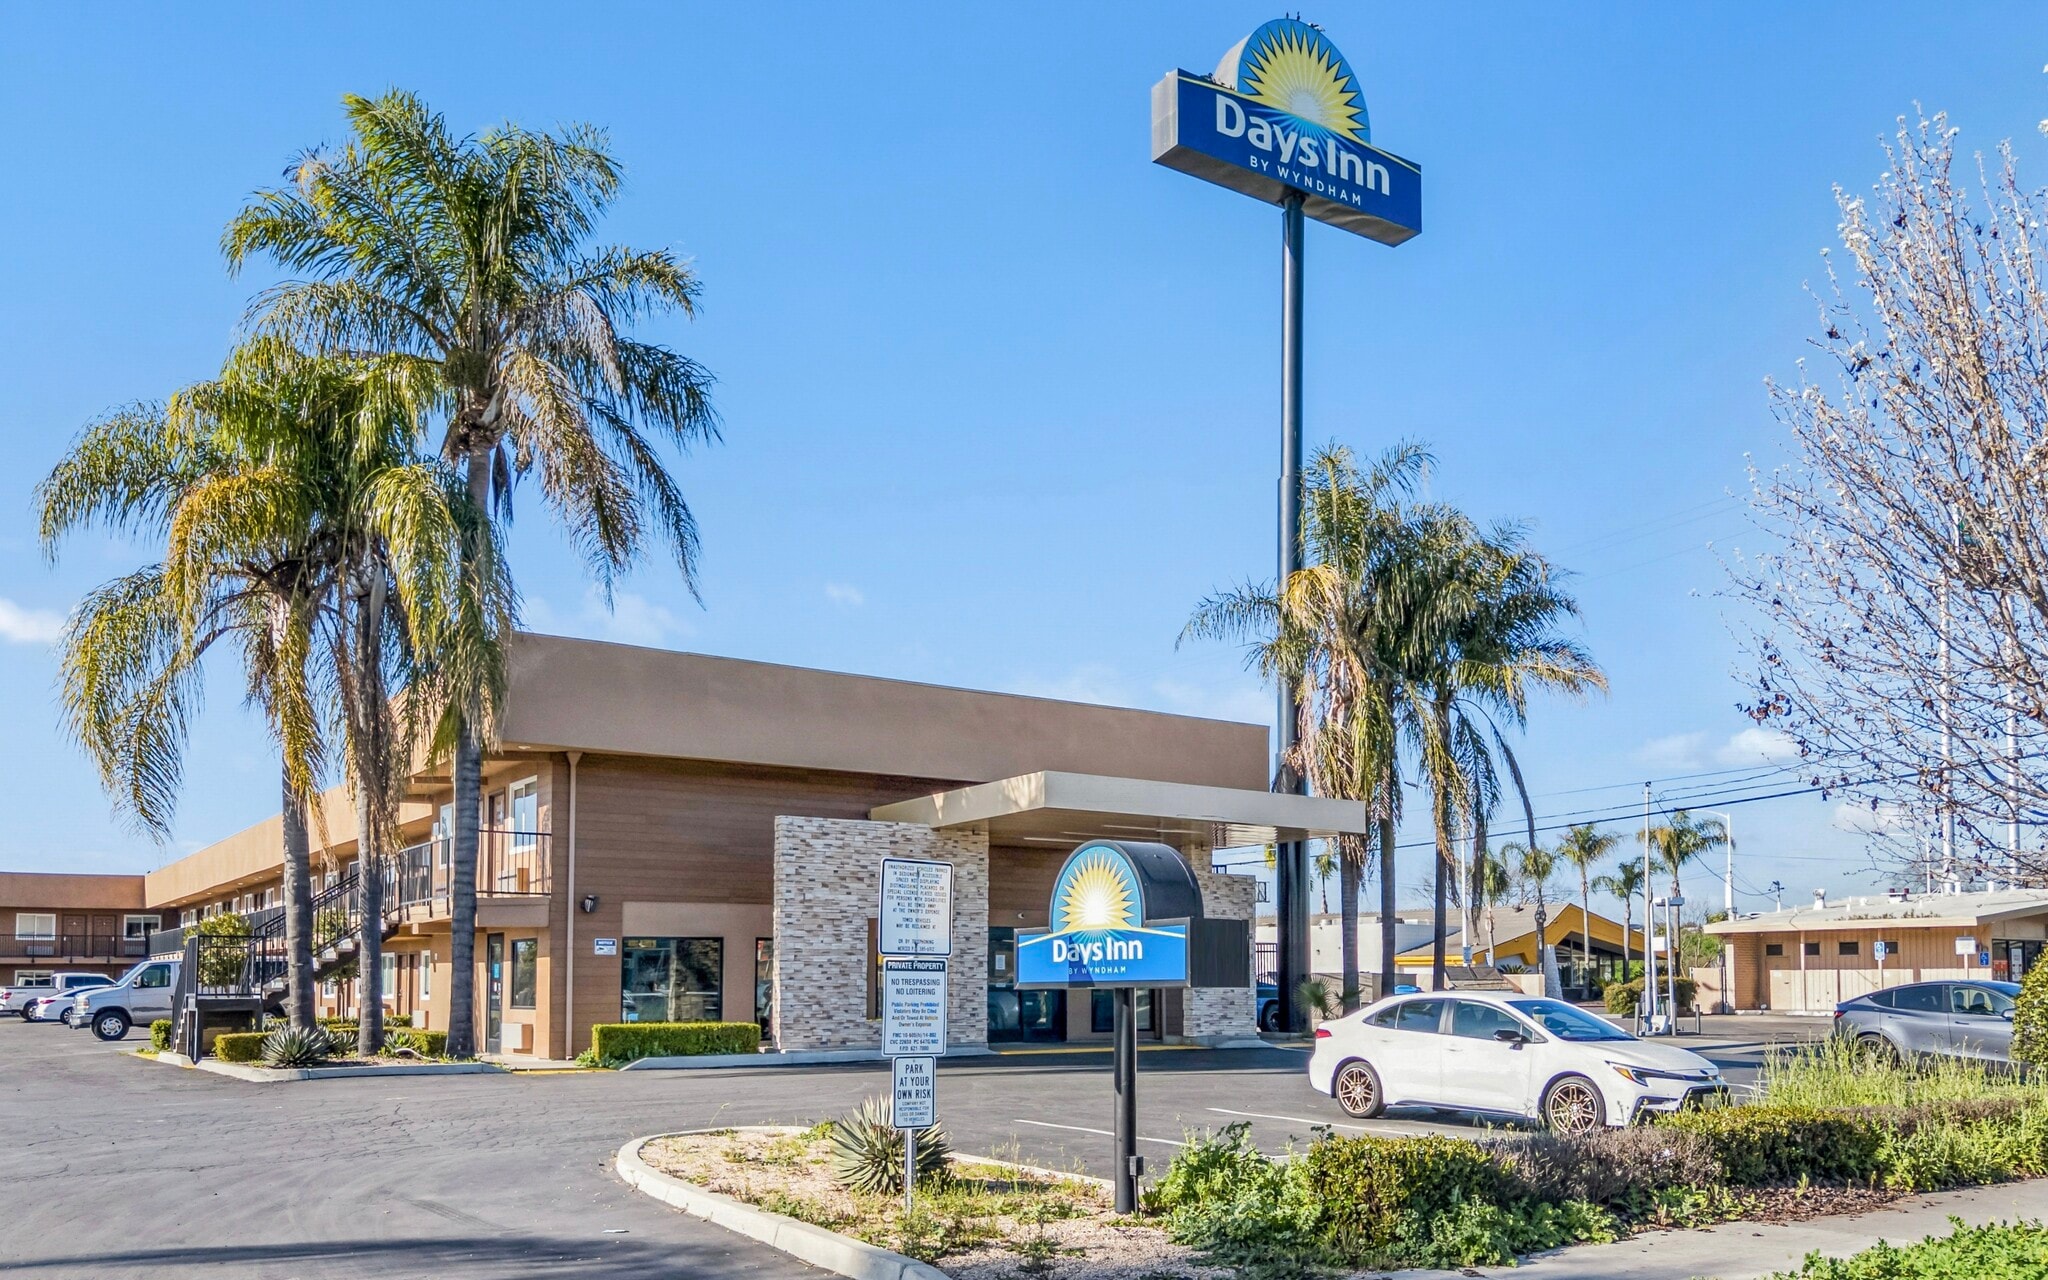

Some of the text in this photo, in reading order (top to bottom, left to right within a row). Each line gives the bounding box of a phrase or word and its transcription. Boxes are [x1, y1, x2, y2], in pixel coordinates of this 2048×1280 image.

[1215, 93, 1390, 196] Days Inn
[1250, 155, 1361, 206] BY WYNDHAM
[1053, 937, 1143, 965] Days Inn
[888, 962, 944, 970] PRIVATE PROPERTY
[1068, 966, 1126, 975] BY WYNDHAM
[891, 978, 900, 986] NO
[906, 988, 936, 996] LOITERING
[905, 1064, 923, 1074] PARK
[899, 1077, 929, 1086] AT YOUR
[897, 1089, 931, 1100] OWN RISK
